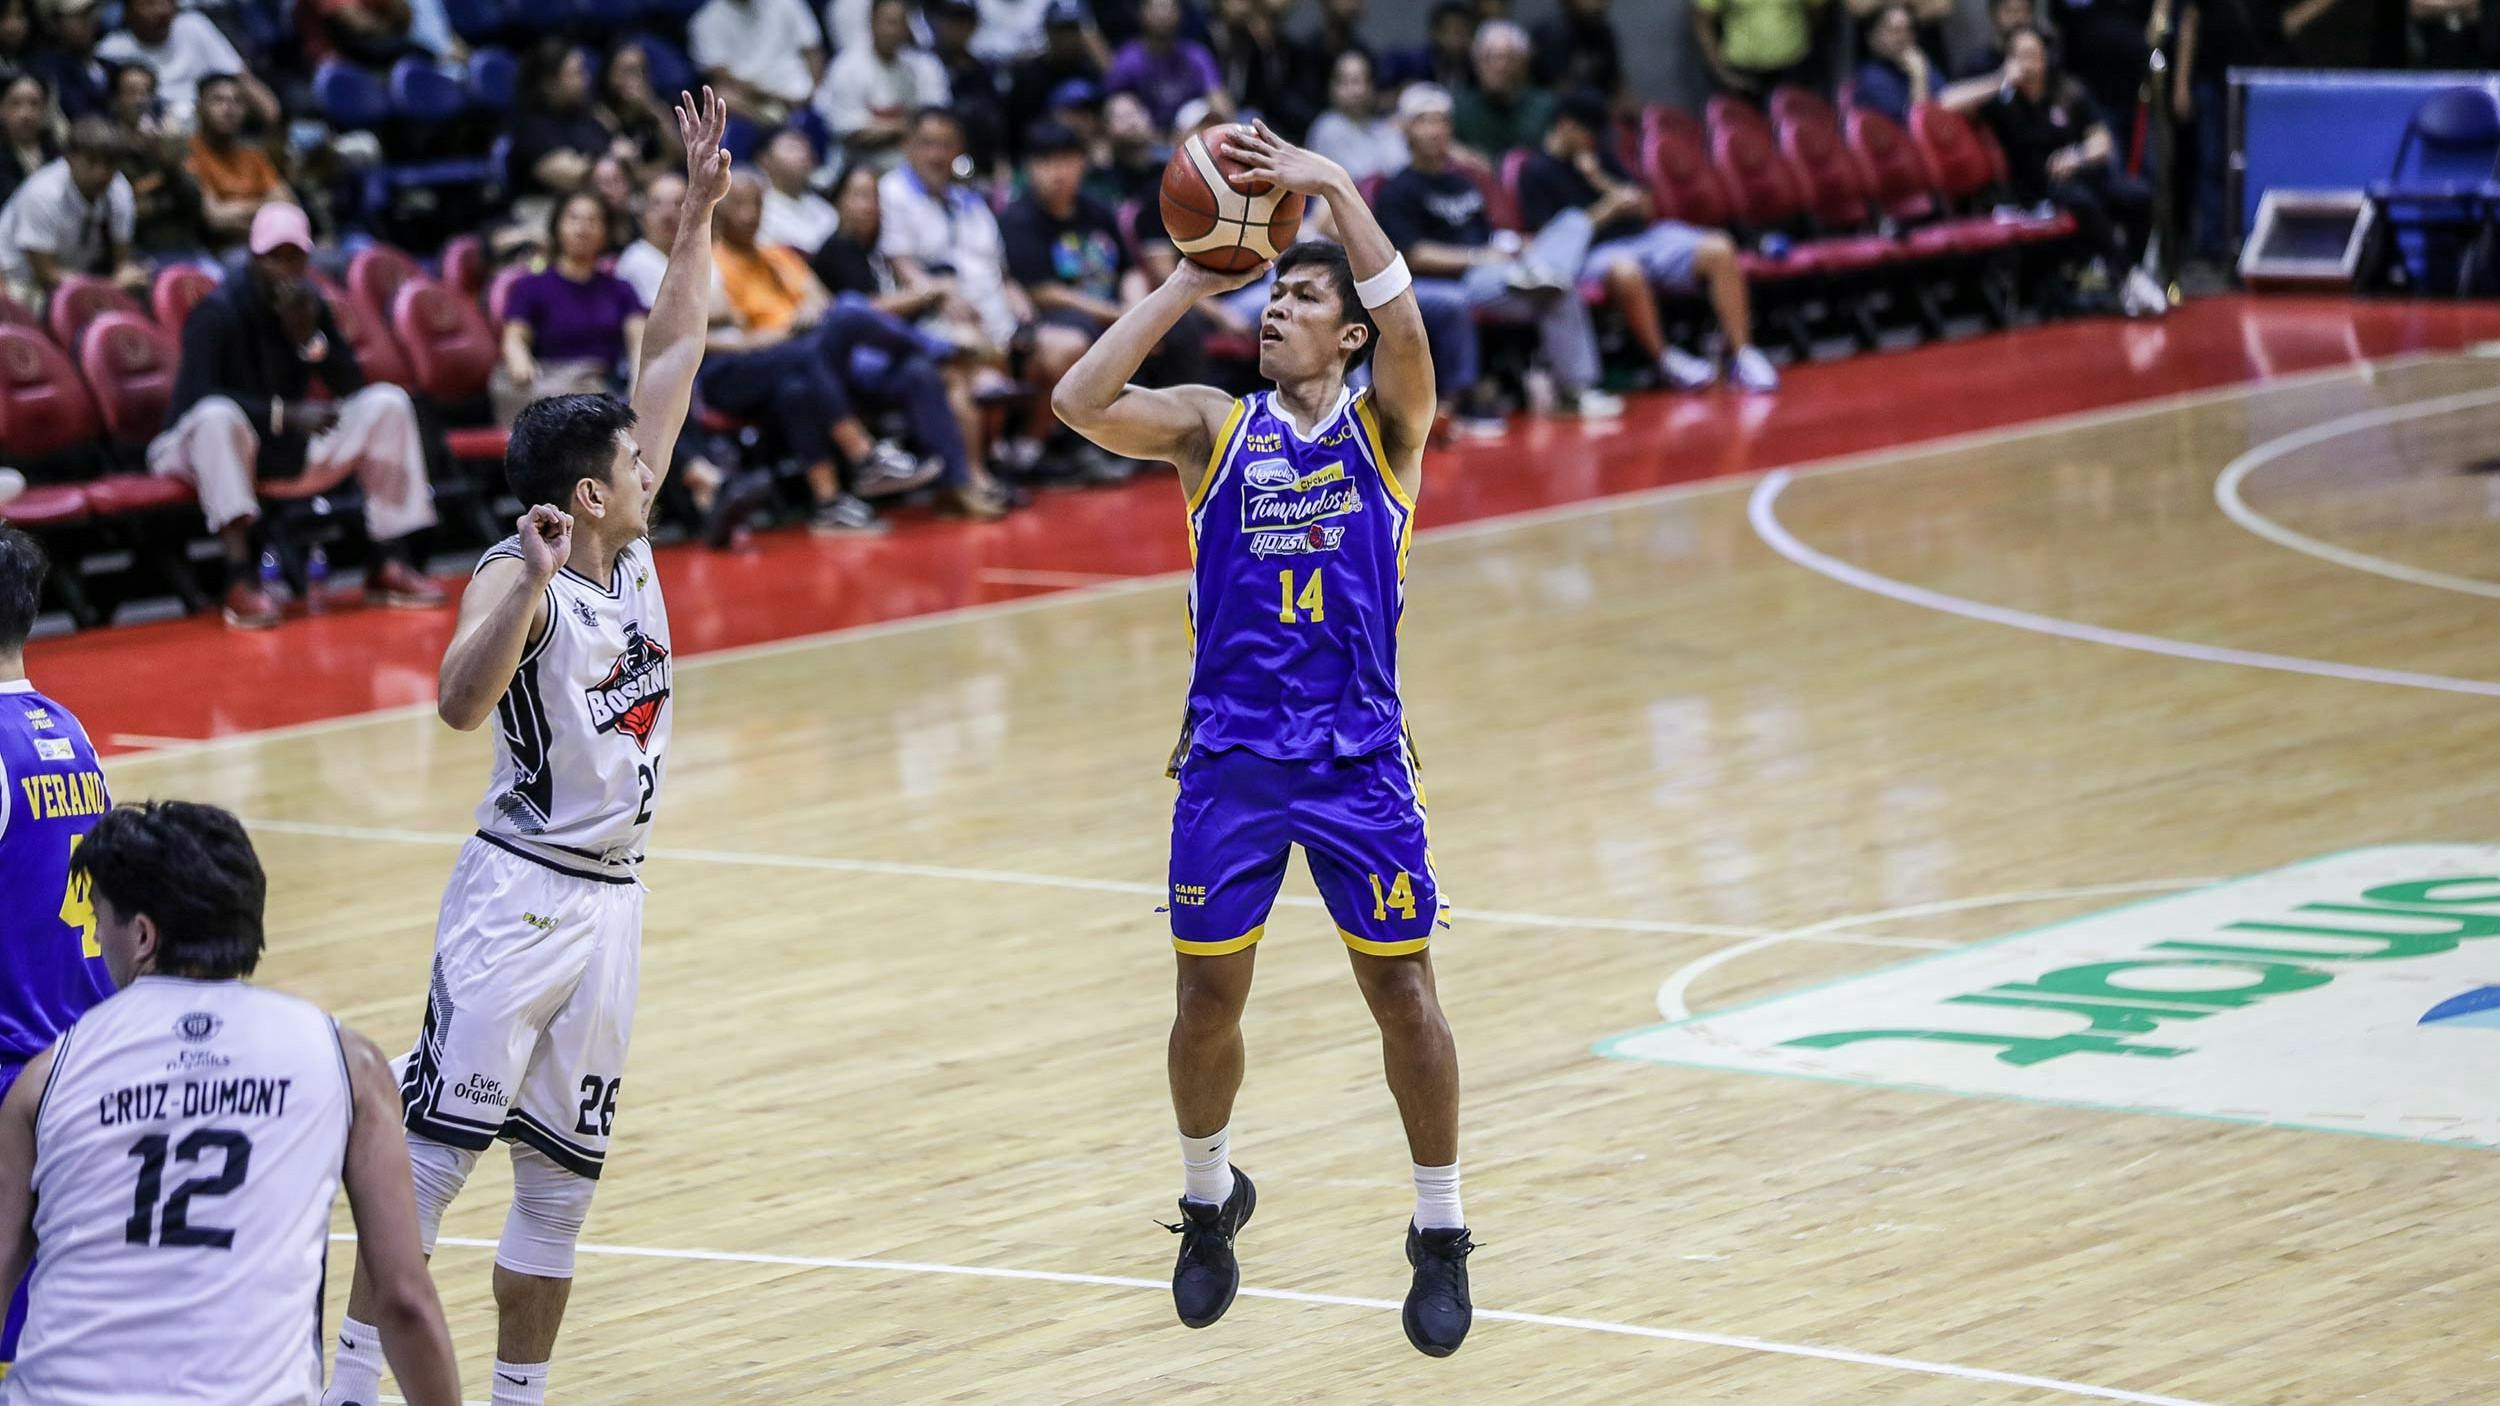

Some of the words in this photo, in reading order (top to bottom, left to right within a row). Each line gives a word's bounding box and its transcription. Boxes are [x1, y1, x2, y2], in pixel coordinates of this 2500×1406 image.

[1248, 442, 1282, 452] VILLE
[1250, 489, 1343, 525] Timplados
[1279, 567, 1325, 624] 14
[21, 772, 105, 820] VERANO
[59, 834, 101, 958] 4
[1175, 883, 1206, 896] GAME
[1175, 894, 1205, 906] VILLE
[1369, 871, 1417, 921] 14
[100, 1077, 291, 1126] CRUZ-DUMONT
[470, 1073, 500, 1092] Ever
[575, 1074, 622, 1136] 26
[126, 1128, 253, 1252] 12
